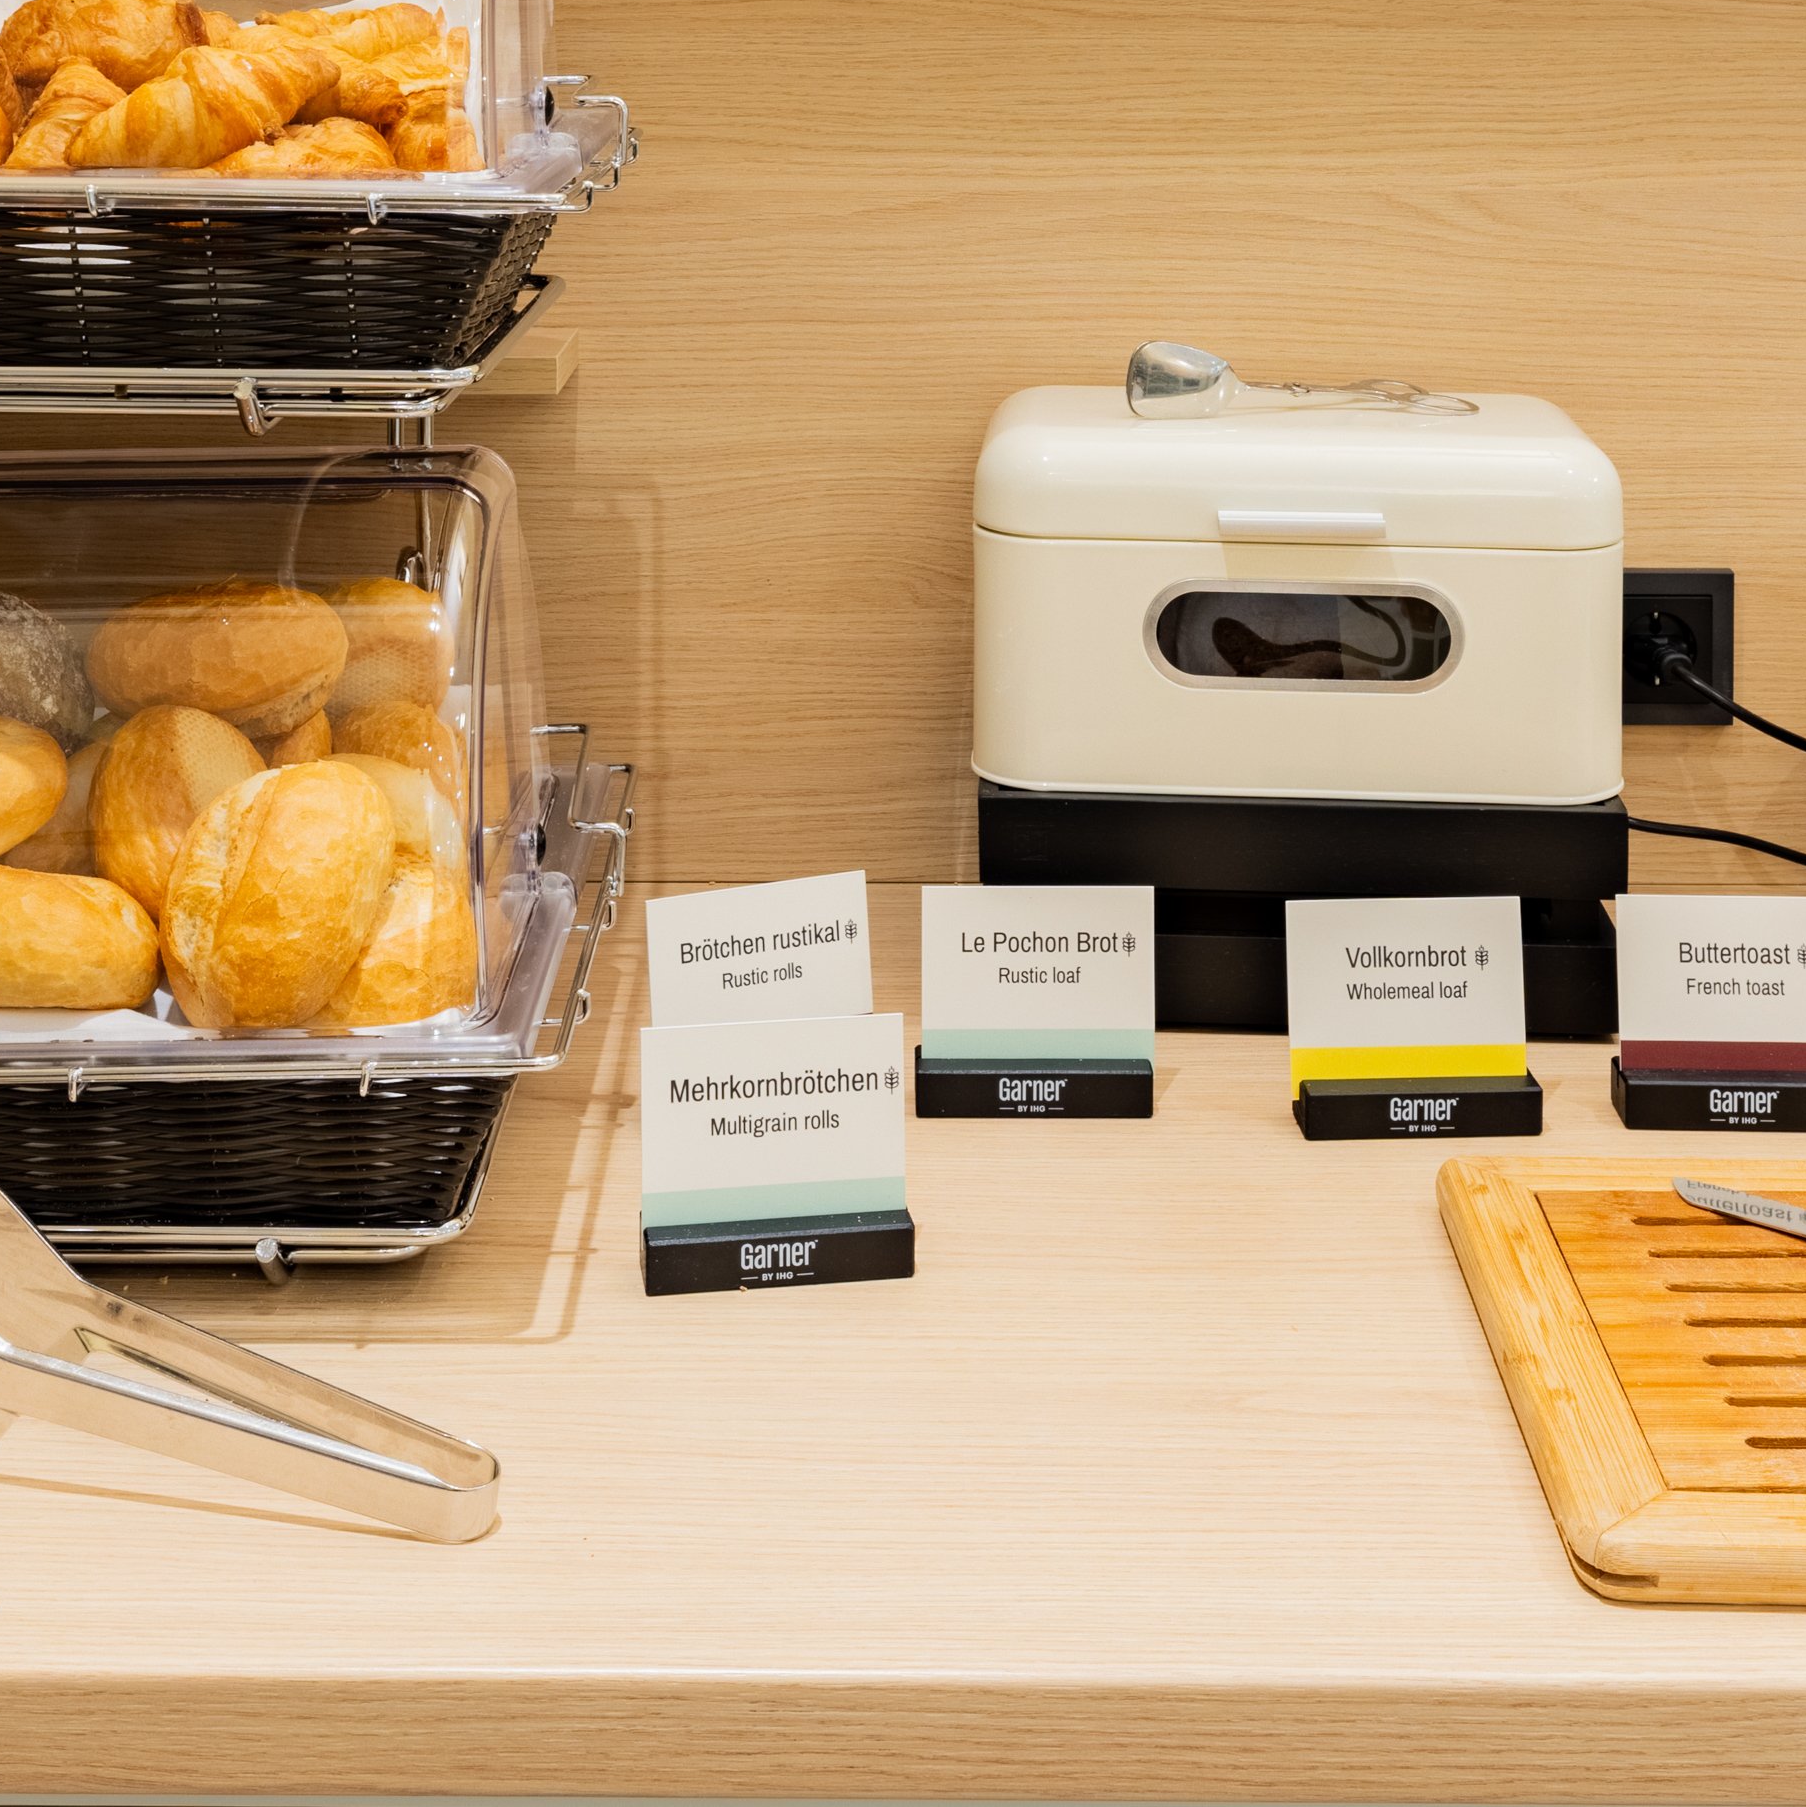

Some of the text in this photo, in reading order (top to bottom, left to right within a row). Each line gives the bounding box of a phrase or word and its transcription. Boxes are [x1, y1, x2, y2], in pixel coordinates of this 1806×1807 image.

[679, 920, 841, 965] Brötchen rustikal
[961, 931, 1119, 954] Le Pochon Brot
[1678, 941, 1791, 965] Buttertoast
[1345, 945, 1467, 969] Vollkornbrot
[721, 962, 803, 990] Rustic rolls
[998, 966, 1081, 984] Rustic loaf
[1686, 977, 1785, 996] French toast
[1346, 980, 1468, 1001] Wholemeal loaf
[669, 1067, 879, 1104] Mehrkornbrötchen
[999, 1077, 1067, 1102] Garner
[1017, 1105, 1046, 1113] BY IHG
[1389, 1096, 1459, 1122] Garner
[1709, 1088, 1779, 1115] Garner
[710, 1110, 840, 1138] Multigrain rolls
[1408, 1124, 1437, 1133] BY IHG
[1728, 1116, 1758, 1125] BY IHG
[740, 1238, 817, 1270] Garner
[761, 1271, 794, 1282] BY IHG
